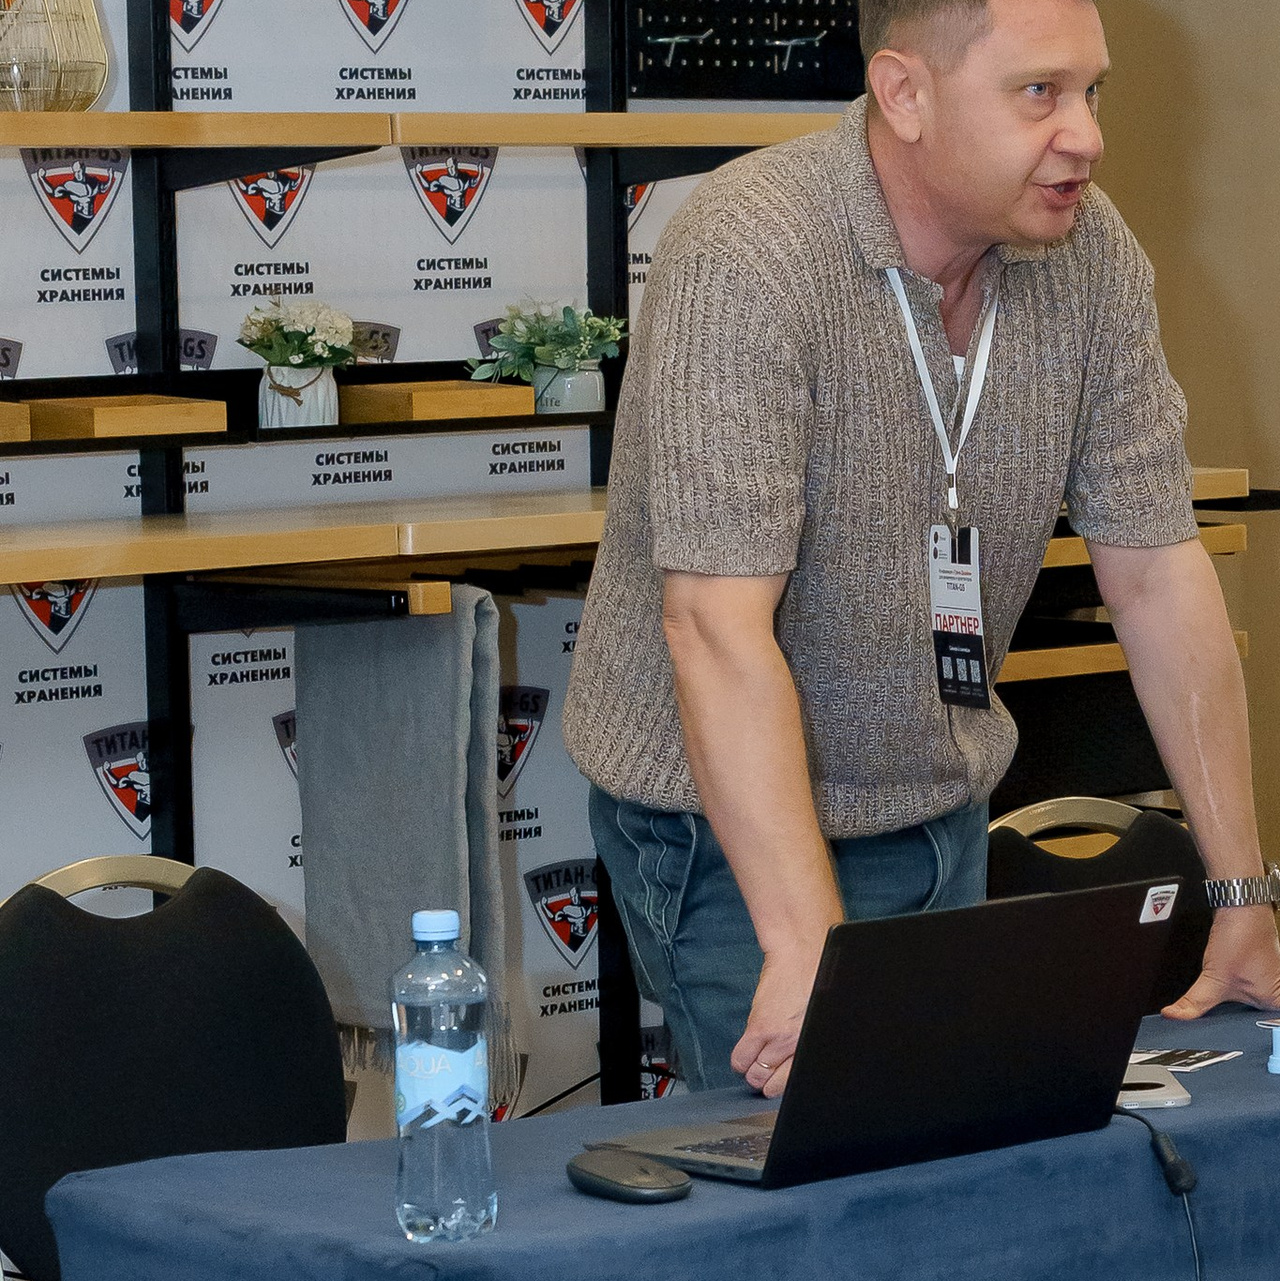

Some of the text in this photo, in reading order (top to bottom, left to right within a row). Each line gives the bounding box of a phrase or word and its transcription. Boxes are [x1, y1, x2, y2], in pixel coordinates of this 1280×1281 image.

[171, 67, 228, 80] СТЕМЫ
[339, 67, 412, 81] СИСТЕМЫ
[171, 87, 233, 100] АНЕНИЯ
[335, 87, 416, 100] ХРАНЕНИЯ
[234, 262, 310, 277] СИСТЕМЫ
[417, 257, 488, 272] СИСТЕМЫ
[40, 267, 120, 282] СИСТЕМЫ
[230, 282, 314, 297] ХРАНЕНИЯ
[413, 277, 492, 291] ХРАНЕНИЯ
[37, 288, 125, 303] ХРАНЕНИЯ
[492, 440, 561, 456] СИСТЕМЫ
[315, 450, 388, 466] СИСТЕМЫ
[488, 459, 565, 475] ХРАНЕНИЯ
[311, 470, 392, 486] ХРАНЕНИЯ
[935, 614, 980, 635] ПАРТНЕР
[211, 648, 287, 666] СИСТЕМЫ
[18, 665, 98, 683] СИСТЕМЫ
[207, 667, 291, 686] ХРАНЕНИЯ
[15, 684, 102, 704] ХРАНЕНИЯ
[498, 807, 539, 823] ТЕМЫ
[543, 978, 599, 998] СИСТЕМ
[540, 998, 600, 1017] ХРАНЕН
